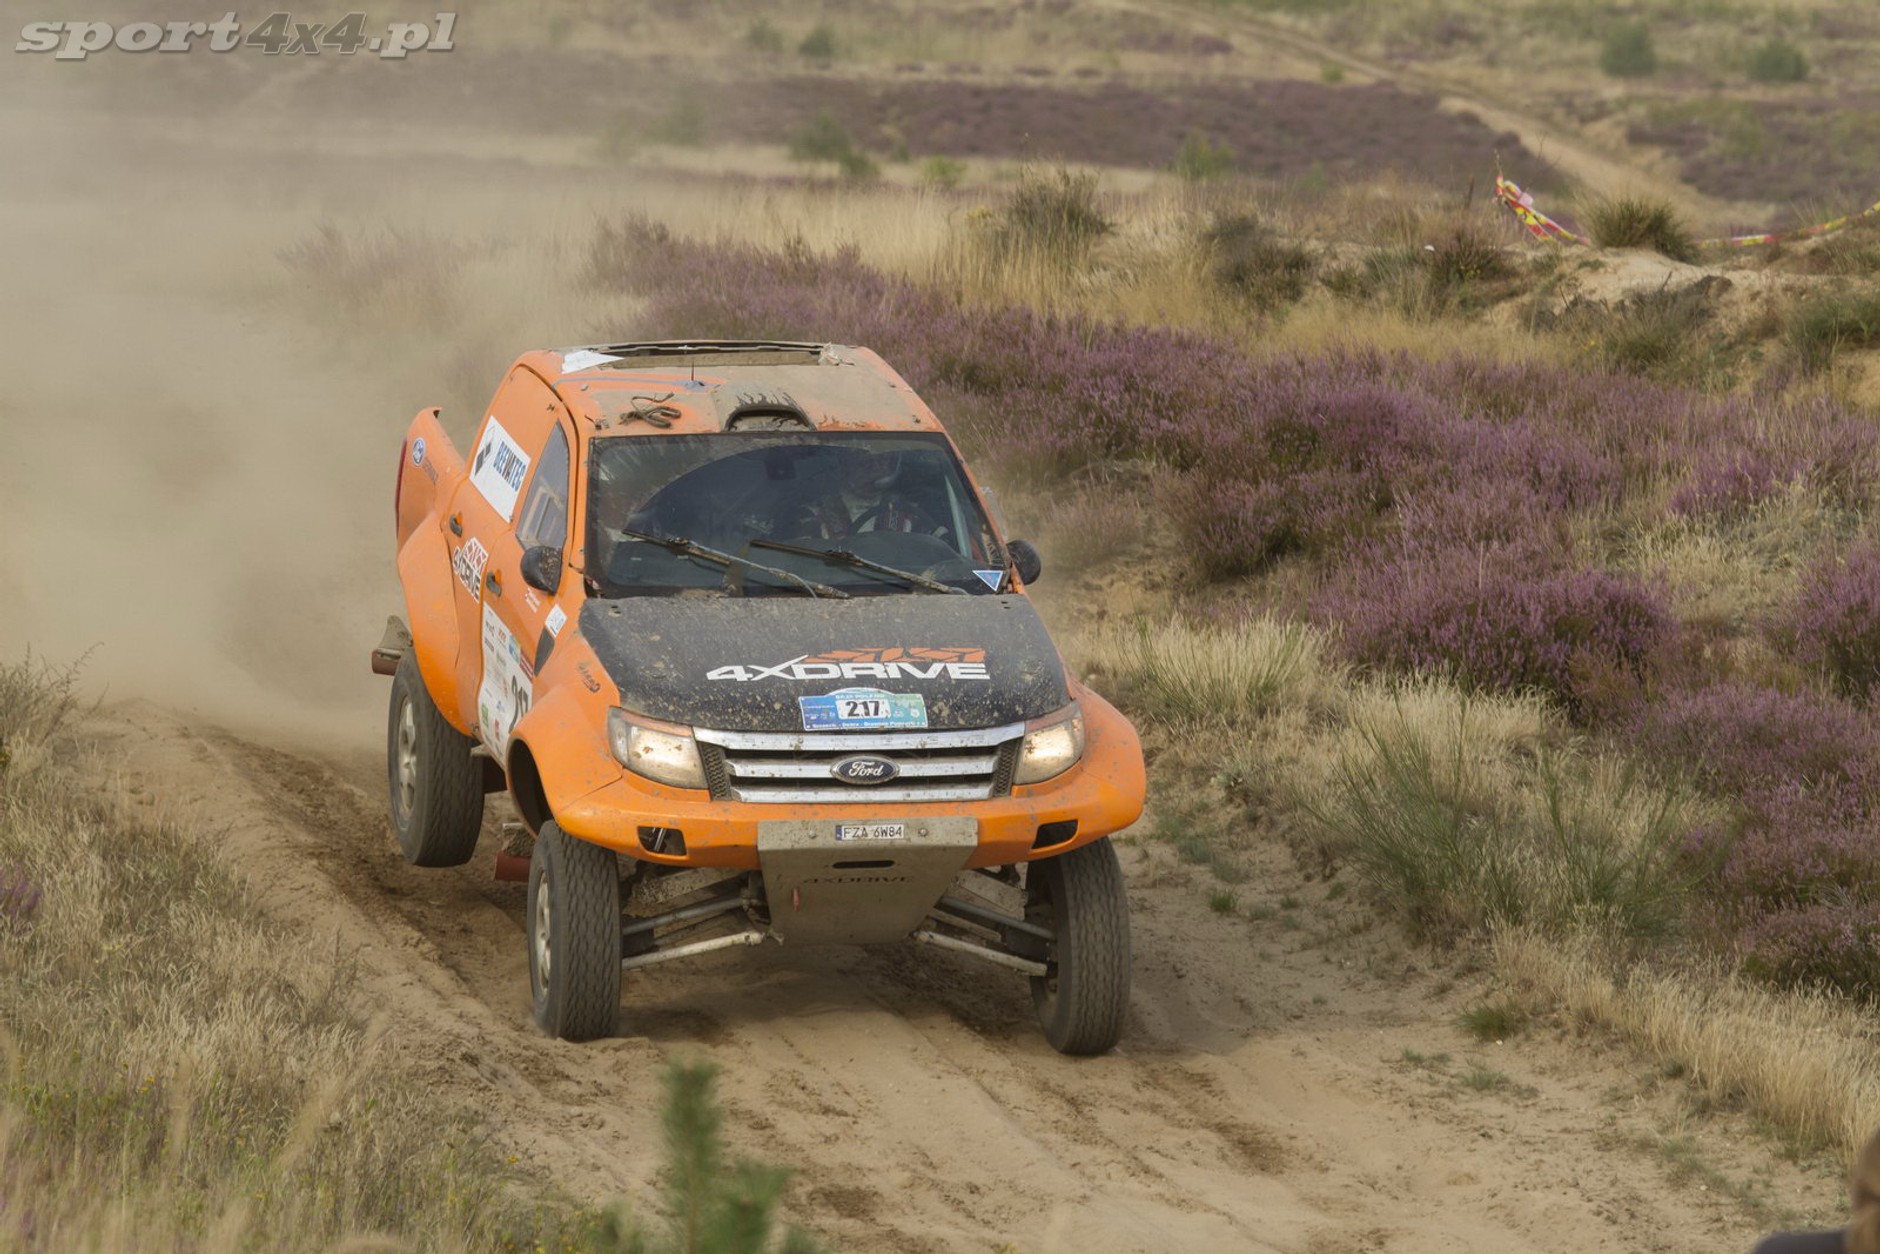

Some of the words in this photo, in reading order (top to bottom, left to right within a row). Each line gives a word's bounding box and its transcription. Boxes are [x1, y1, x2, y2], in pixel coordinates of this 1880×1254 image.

[845, 700, 881, 717] 217
[848, 761, 884, 777] Ford
[843, 826, 868, 839] FZA
[873, 826, 902, 838] 6W84
